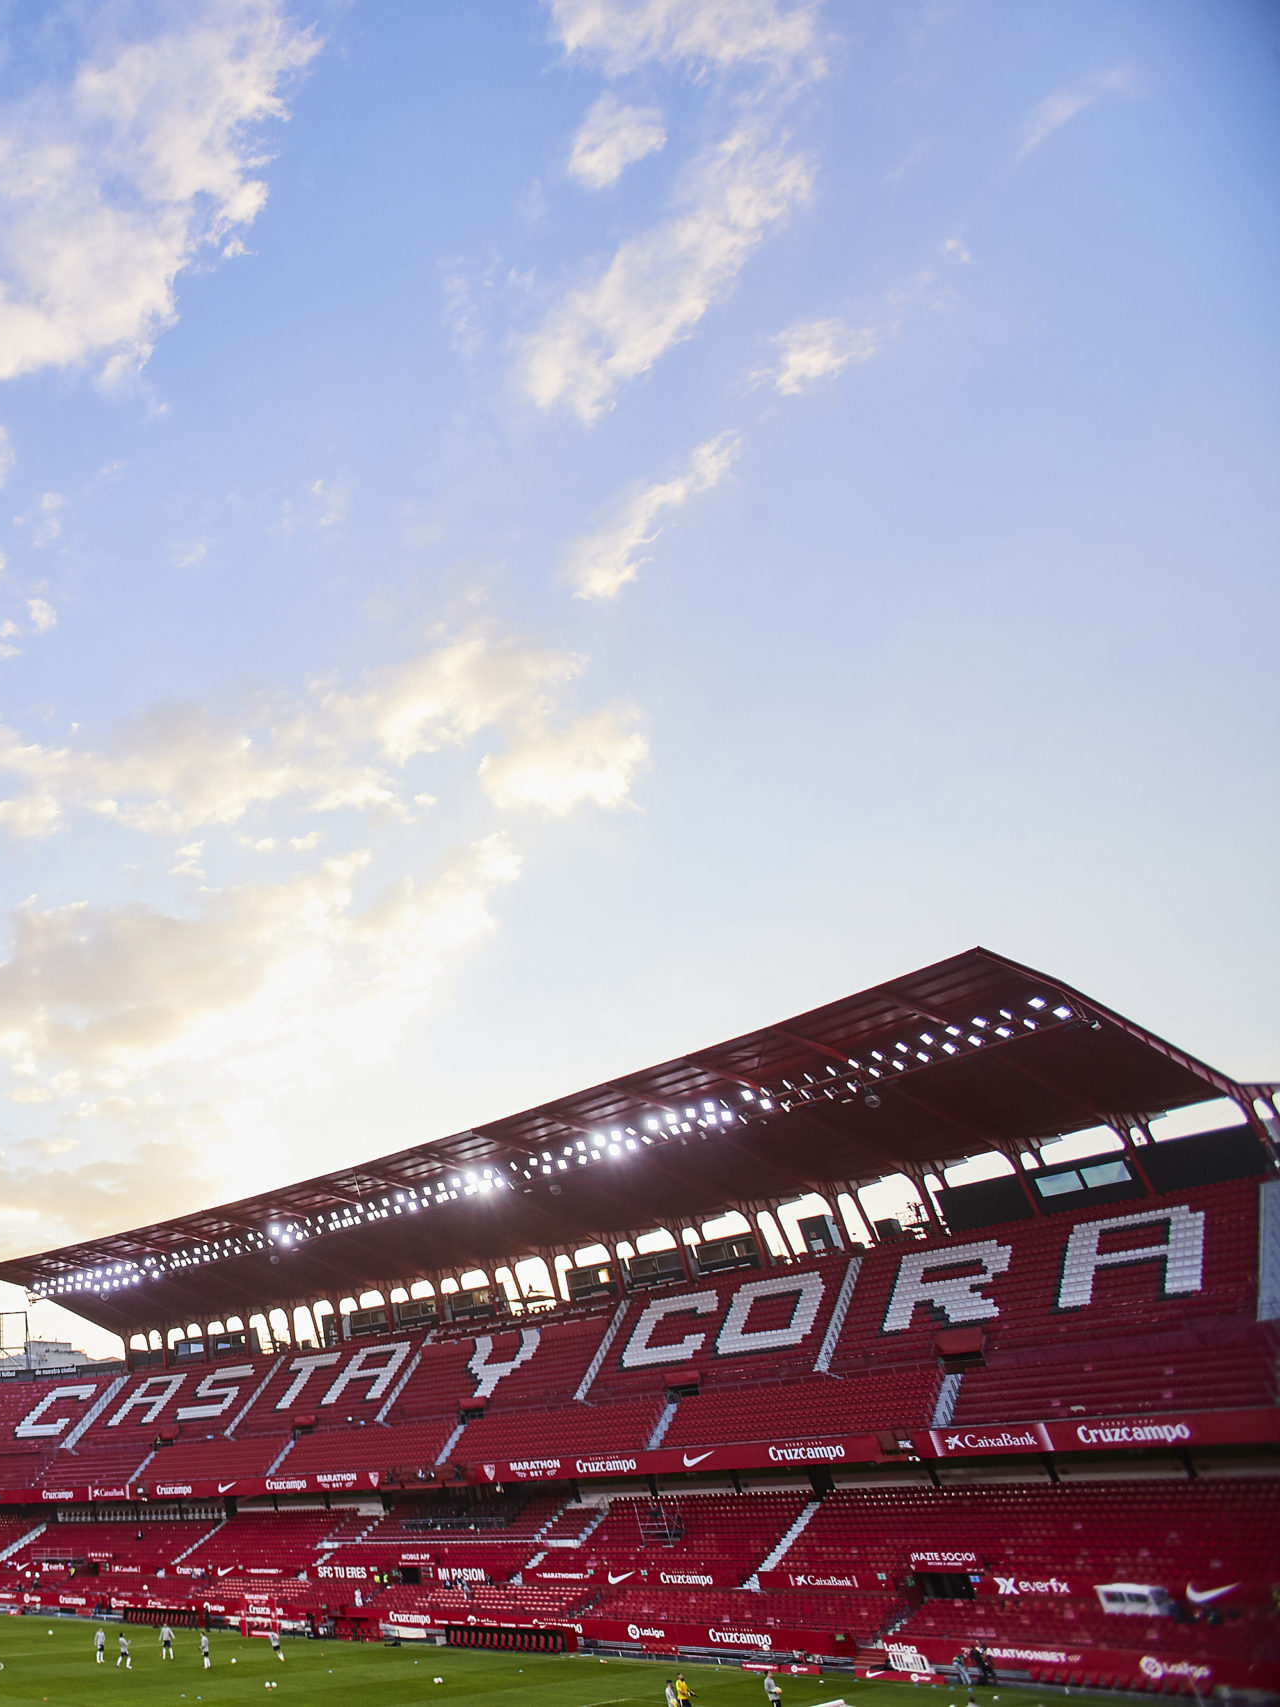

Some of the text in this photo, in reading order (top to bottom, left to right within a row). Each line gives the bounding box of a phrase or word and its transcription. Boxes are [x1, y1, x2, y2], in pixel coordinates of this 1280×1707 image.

[16, 1205, 1205, 1437] CASTA Y CORA
[964, 1431, 1038, 1449] CaixaBank
[1076, 1424, 1191, 1443] Cruzcampo
[768, 1445, 846, 1461] Cruzcampo
[509, 1459, 561, 1471] MARATHON
[576, 1459, 637, 1473] Cruzcampo
[266, 1478, 307, 1490] Cruzcampo
[317, 1473, 357, 1483] MARATHON
[42, 1490, 74, 1500] Cruzcampo
[99, 1488, 125, 1497] CaixaBank
[156, 1484, 192, 1496] Cruzcampo
[910, 1552, 977, 1562] ¡HAZTE SOCIO!
[317, 1566, 367, 1579] SFC TU ERES
[438, 1568, 485, 1581] MI PASION
[660, 1571, 713, 1587] Cruzcampo
[807, 1575, 853, 1587] CaixaBank
[1019, 1577, 1070, 1593] everfx
[389, 1611, 431, 1625] Cruzcampo
[708, 1628, 772, 1647] Cruzcampo
[883, 1642, 917, 1654] LaLiga
